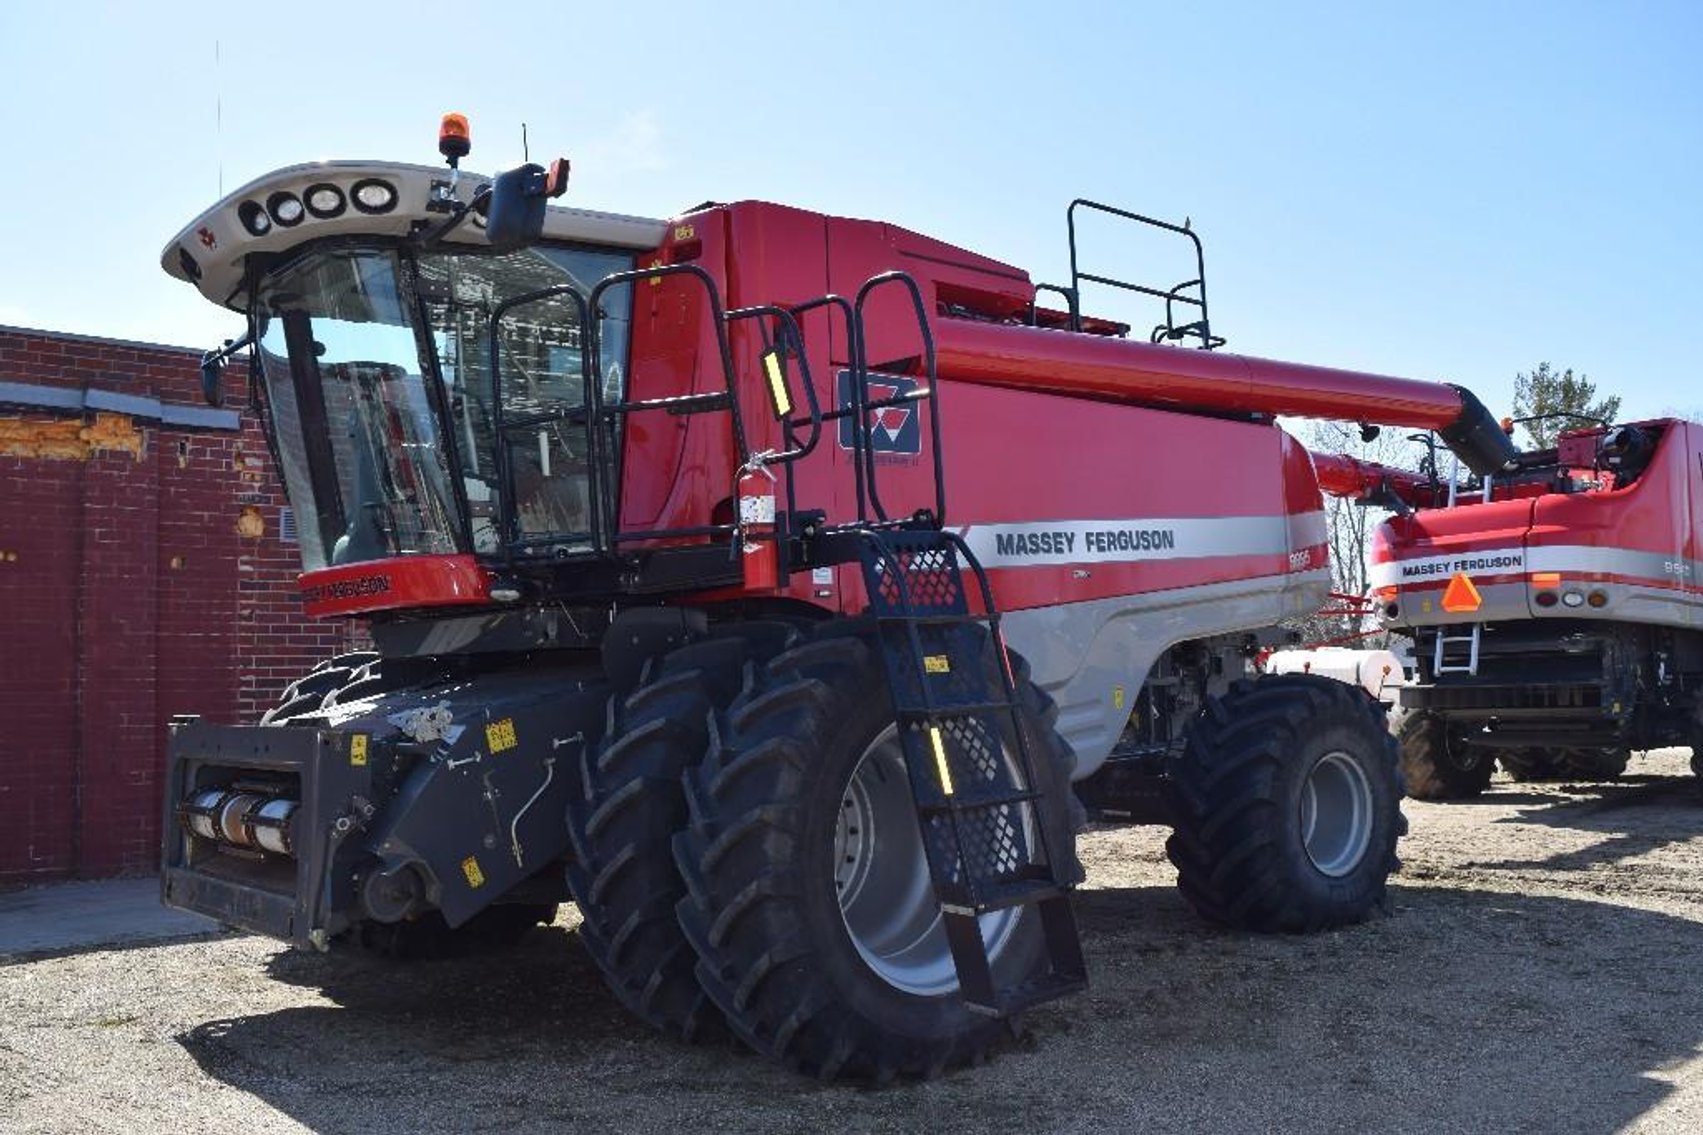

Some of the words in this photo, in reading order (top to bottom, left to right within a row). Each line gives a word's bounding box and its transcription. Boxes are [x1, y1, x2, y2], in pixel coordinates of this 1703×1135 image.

[995, 531, 1076, 556] MASSEY
[1084, 530, 1175, 553] FERGUSON
[1402, 562, 1450, 577] MASSEY
[1454, 556, 1522, 571] FERGUSON
